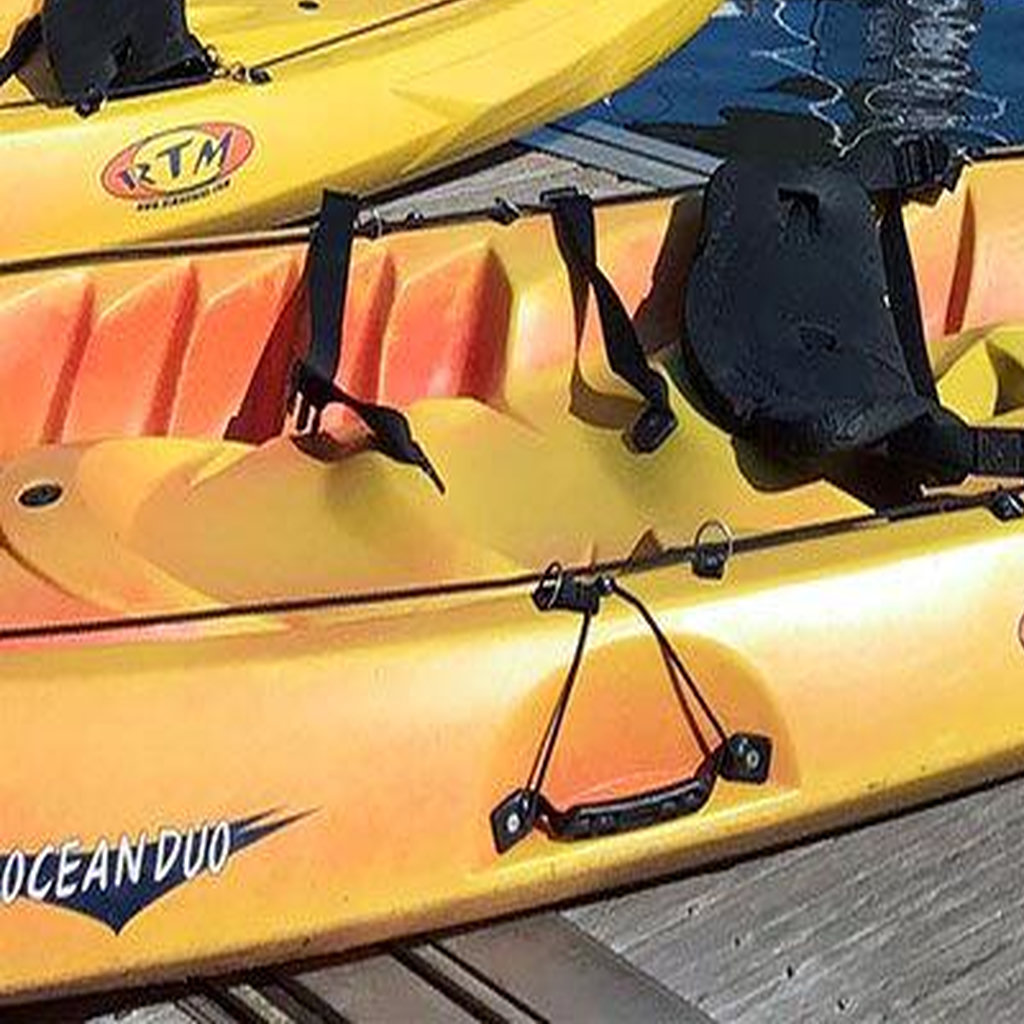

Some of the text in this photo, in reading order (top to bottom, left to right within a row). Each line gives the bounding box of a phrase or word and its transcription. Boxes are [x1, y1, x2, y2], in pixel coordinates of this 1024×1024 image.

[121, 130, 234, 191] RTM
[0, 822, 231, 903] OCEAN DUO
